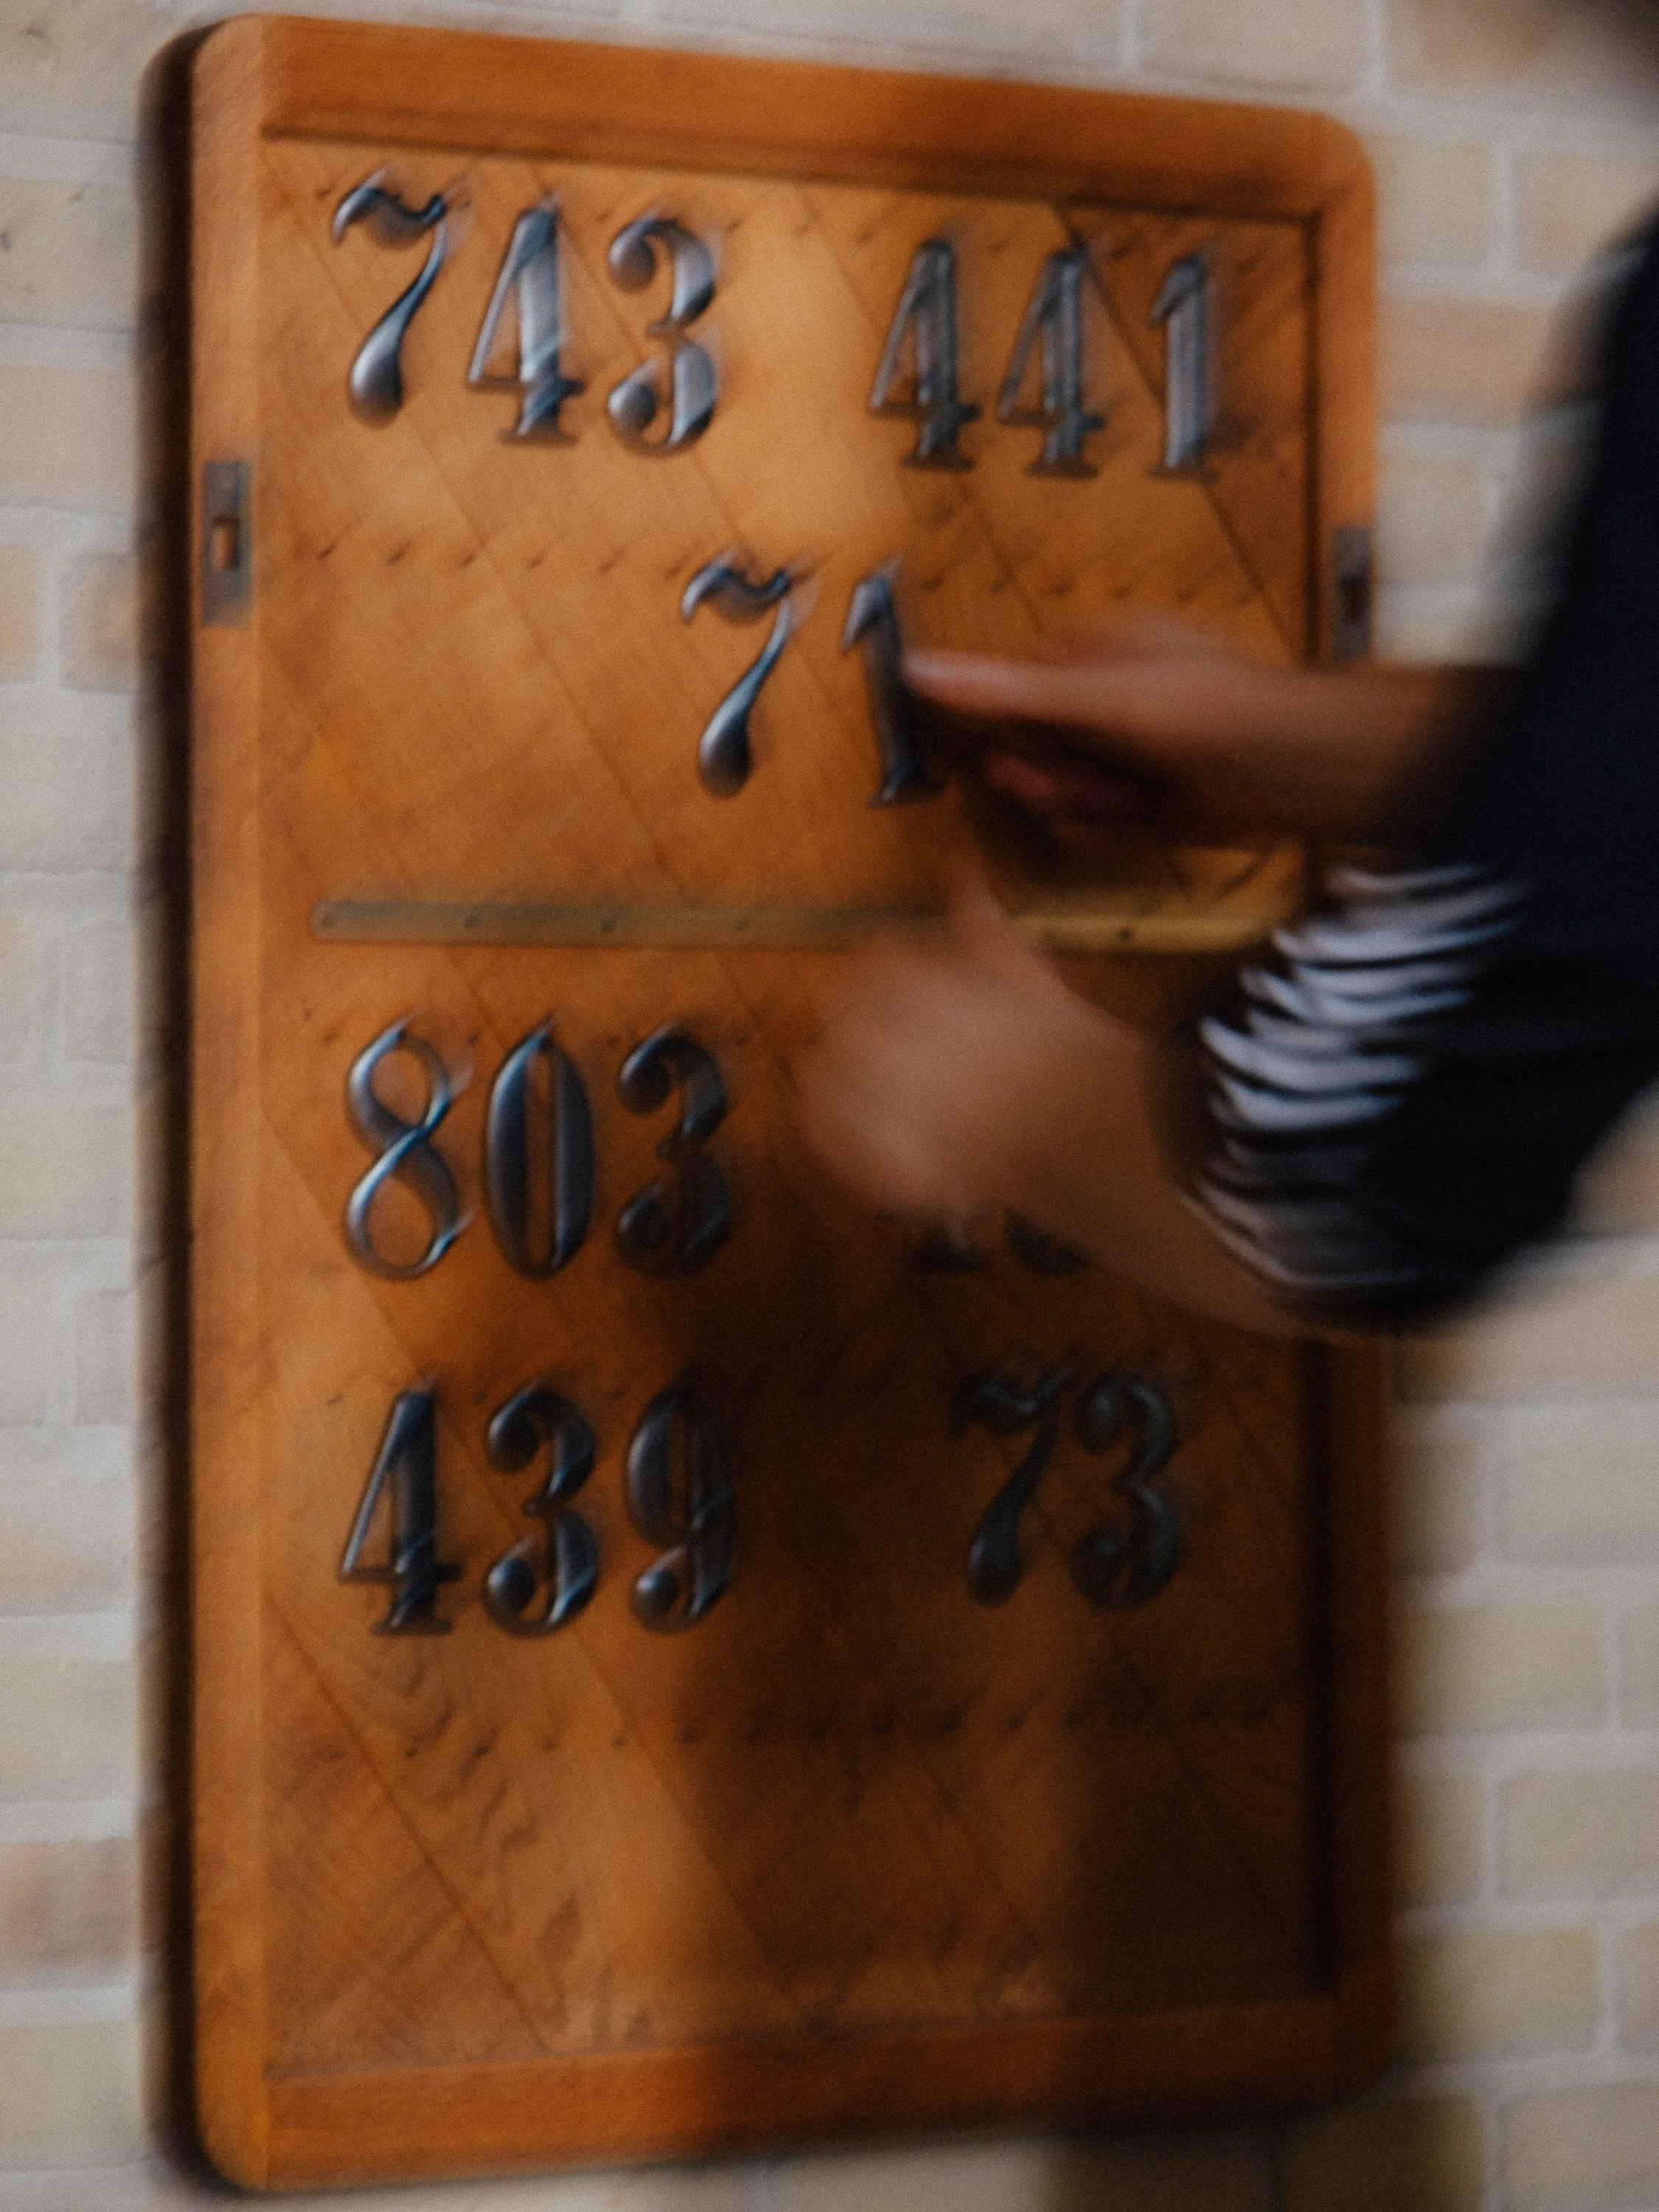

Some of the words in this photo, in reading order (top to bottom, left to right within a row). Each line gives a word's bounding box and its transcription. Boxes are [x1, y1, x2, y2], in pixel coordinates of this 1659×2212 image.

[332, 168, 719, 459] 743
[868, 236, 1218, 481] 441
[681, 549, 945, 807] 71
[345, 1018, 731, 1281] 803
[339, 1377, 737, 1637] 439
[950, 1355, 1178, 1609] 73
